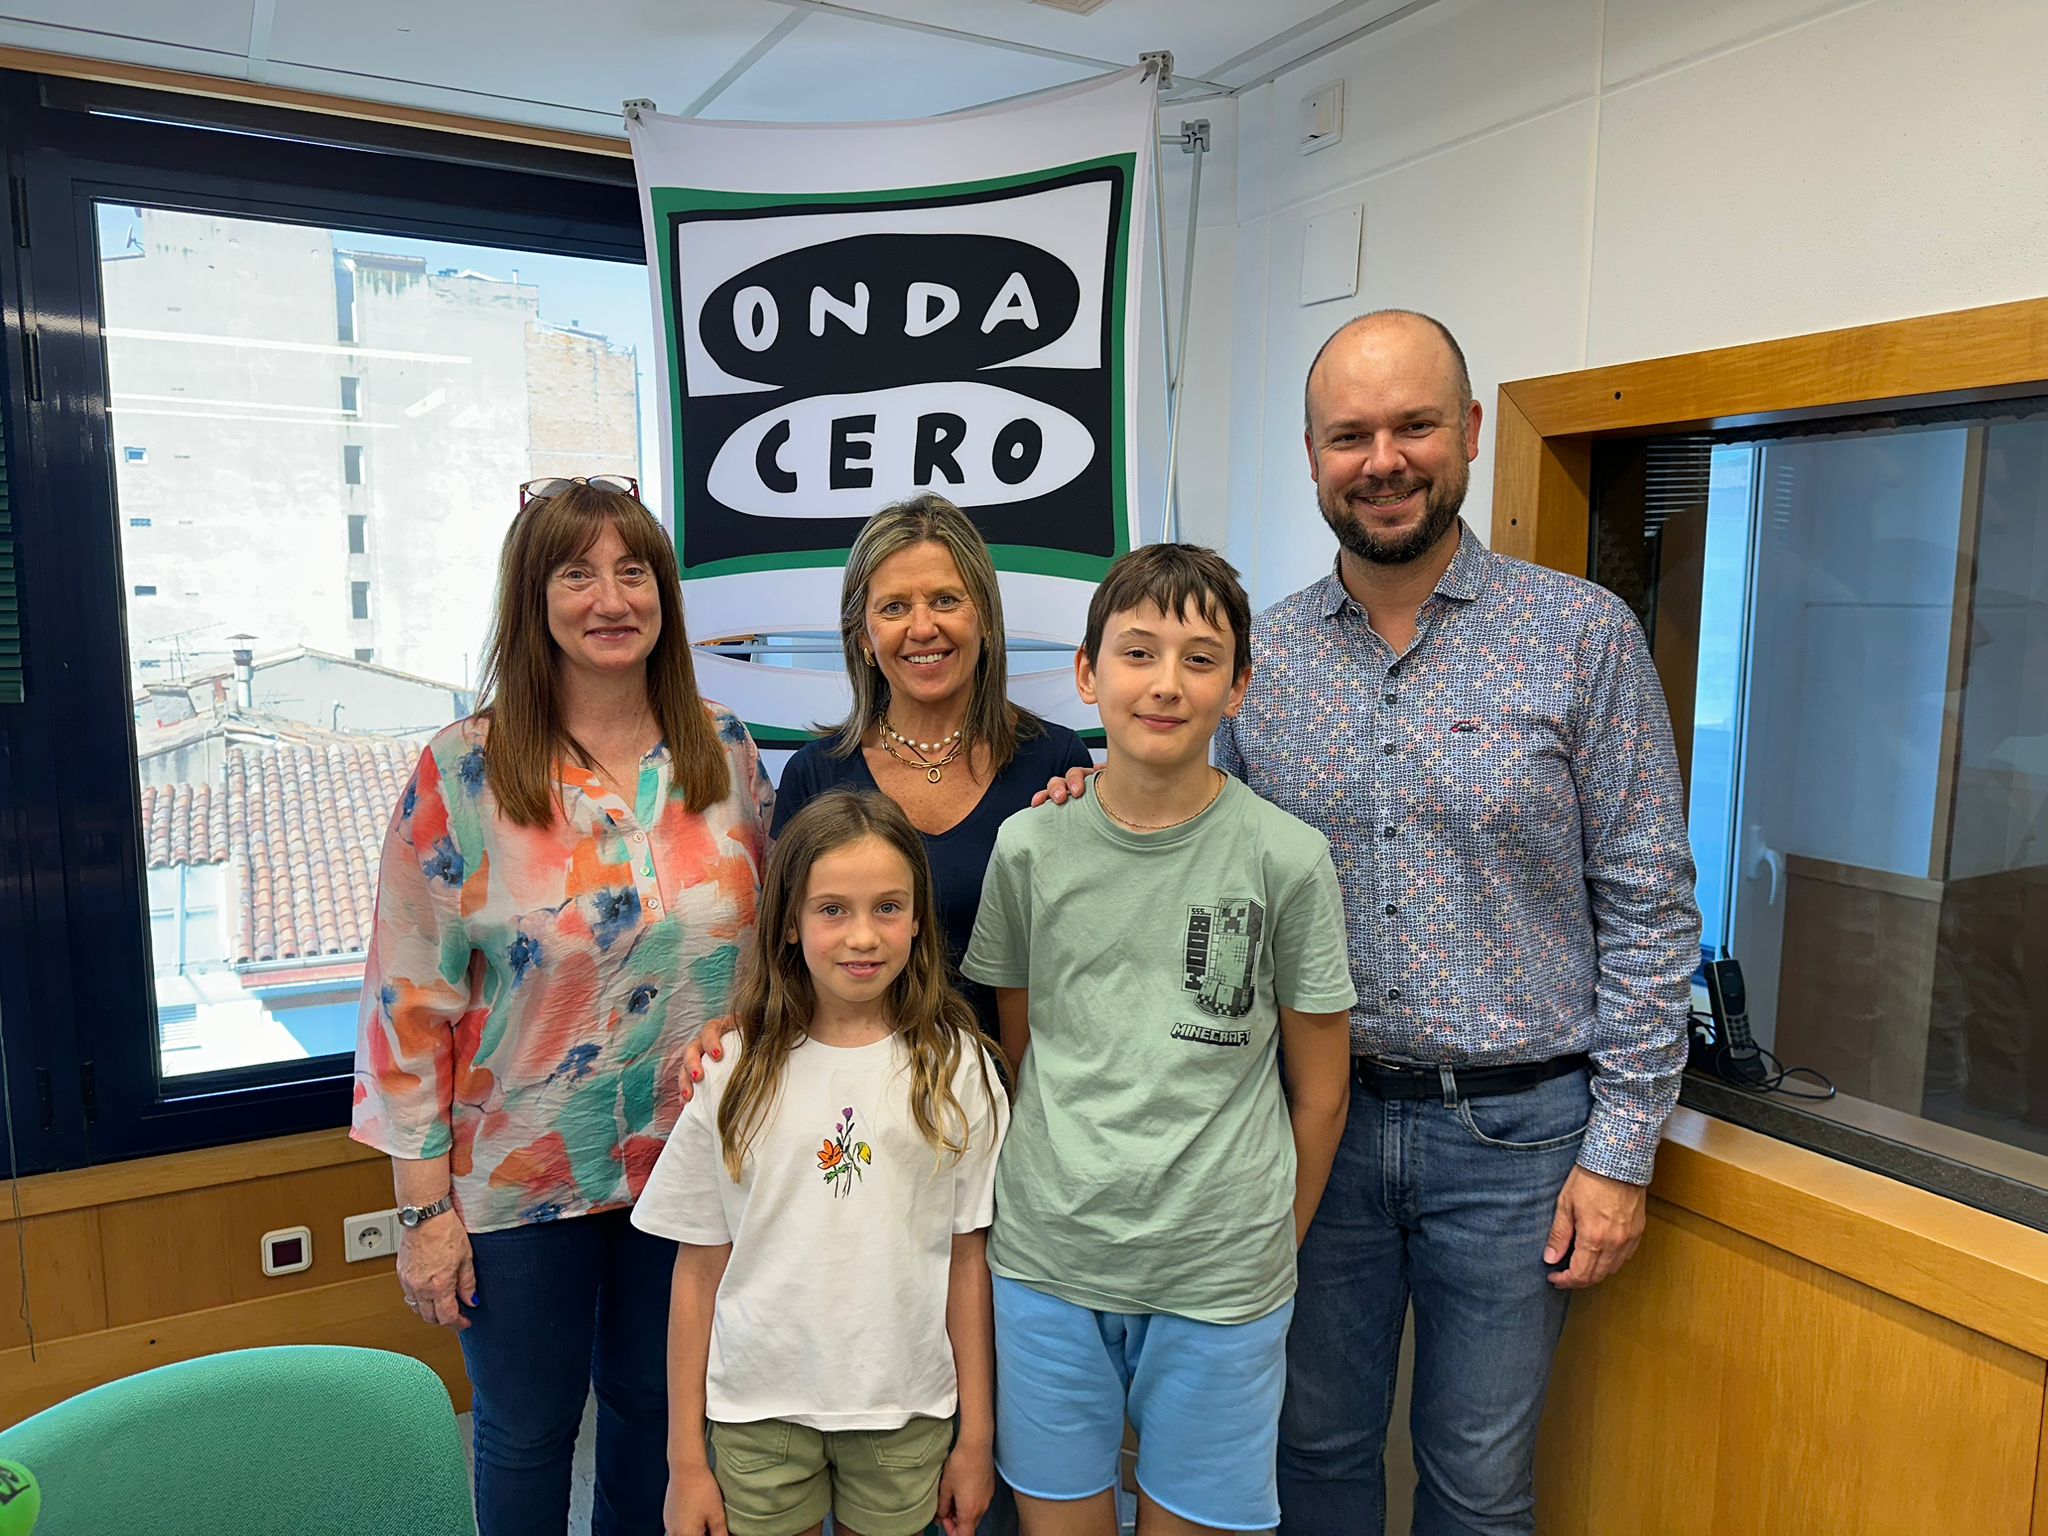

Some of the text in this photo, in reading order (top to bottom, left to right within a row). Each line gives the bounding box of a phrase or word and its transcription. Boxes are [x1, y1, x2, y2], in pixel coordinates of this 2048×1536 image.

[732, 272, 1039, 352] ONDA
[755, 412, 1043, 493] CERO
[1171, 1023, 1250, 1046] MINECRAFT
